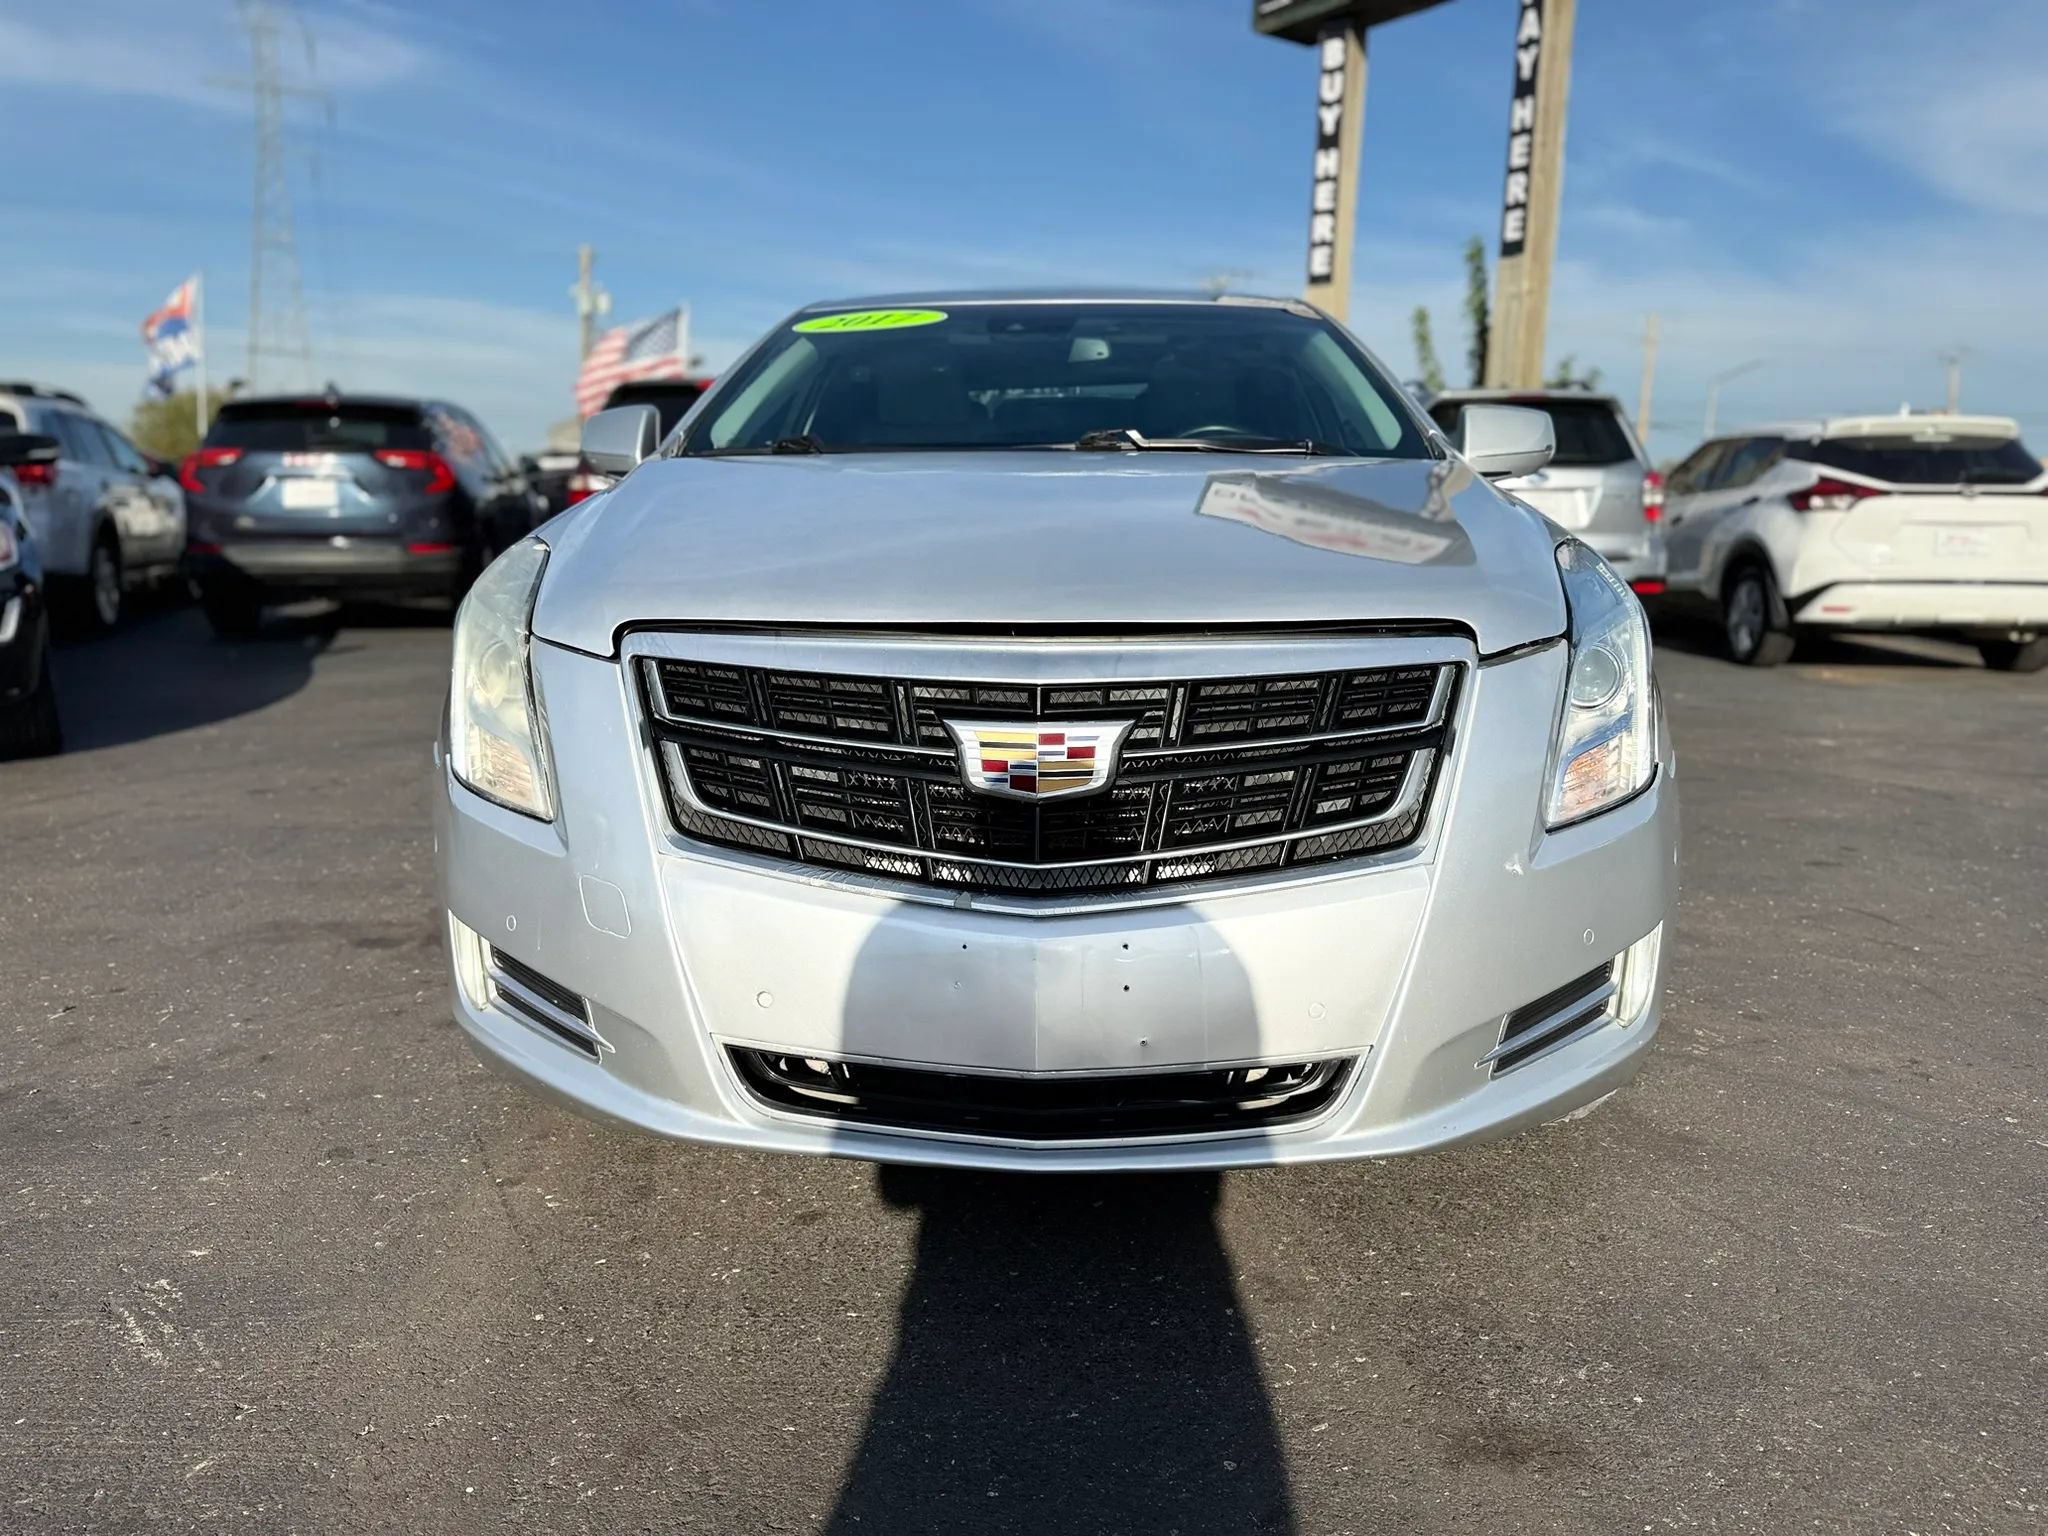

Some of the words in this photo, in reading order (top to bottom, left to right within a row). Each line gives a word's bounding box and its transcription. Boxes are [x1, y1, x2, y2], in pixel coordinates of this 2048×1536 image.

[1319, 37, 1345, 137] BUY
[1517, 0, 1541, 81] AY
[1309, 148, 1339, 276] HERE
[1503, 95, 1535, 242] HERE
